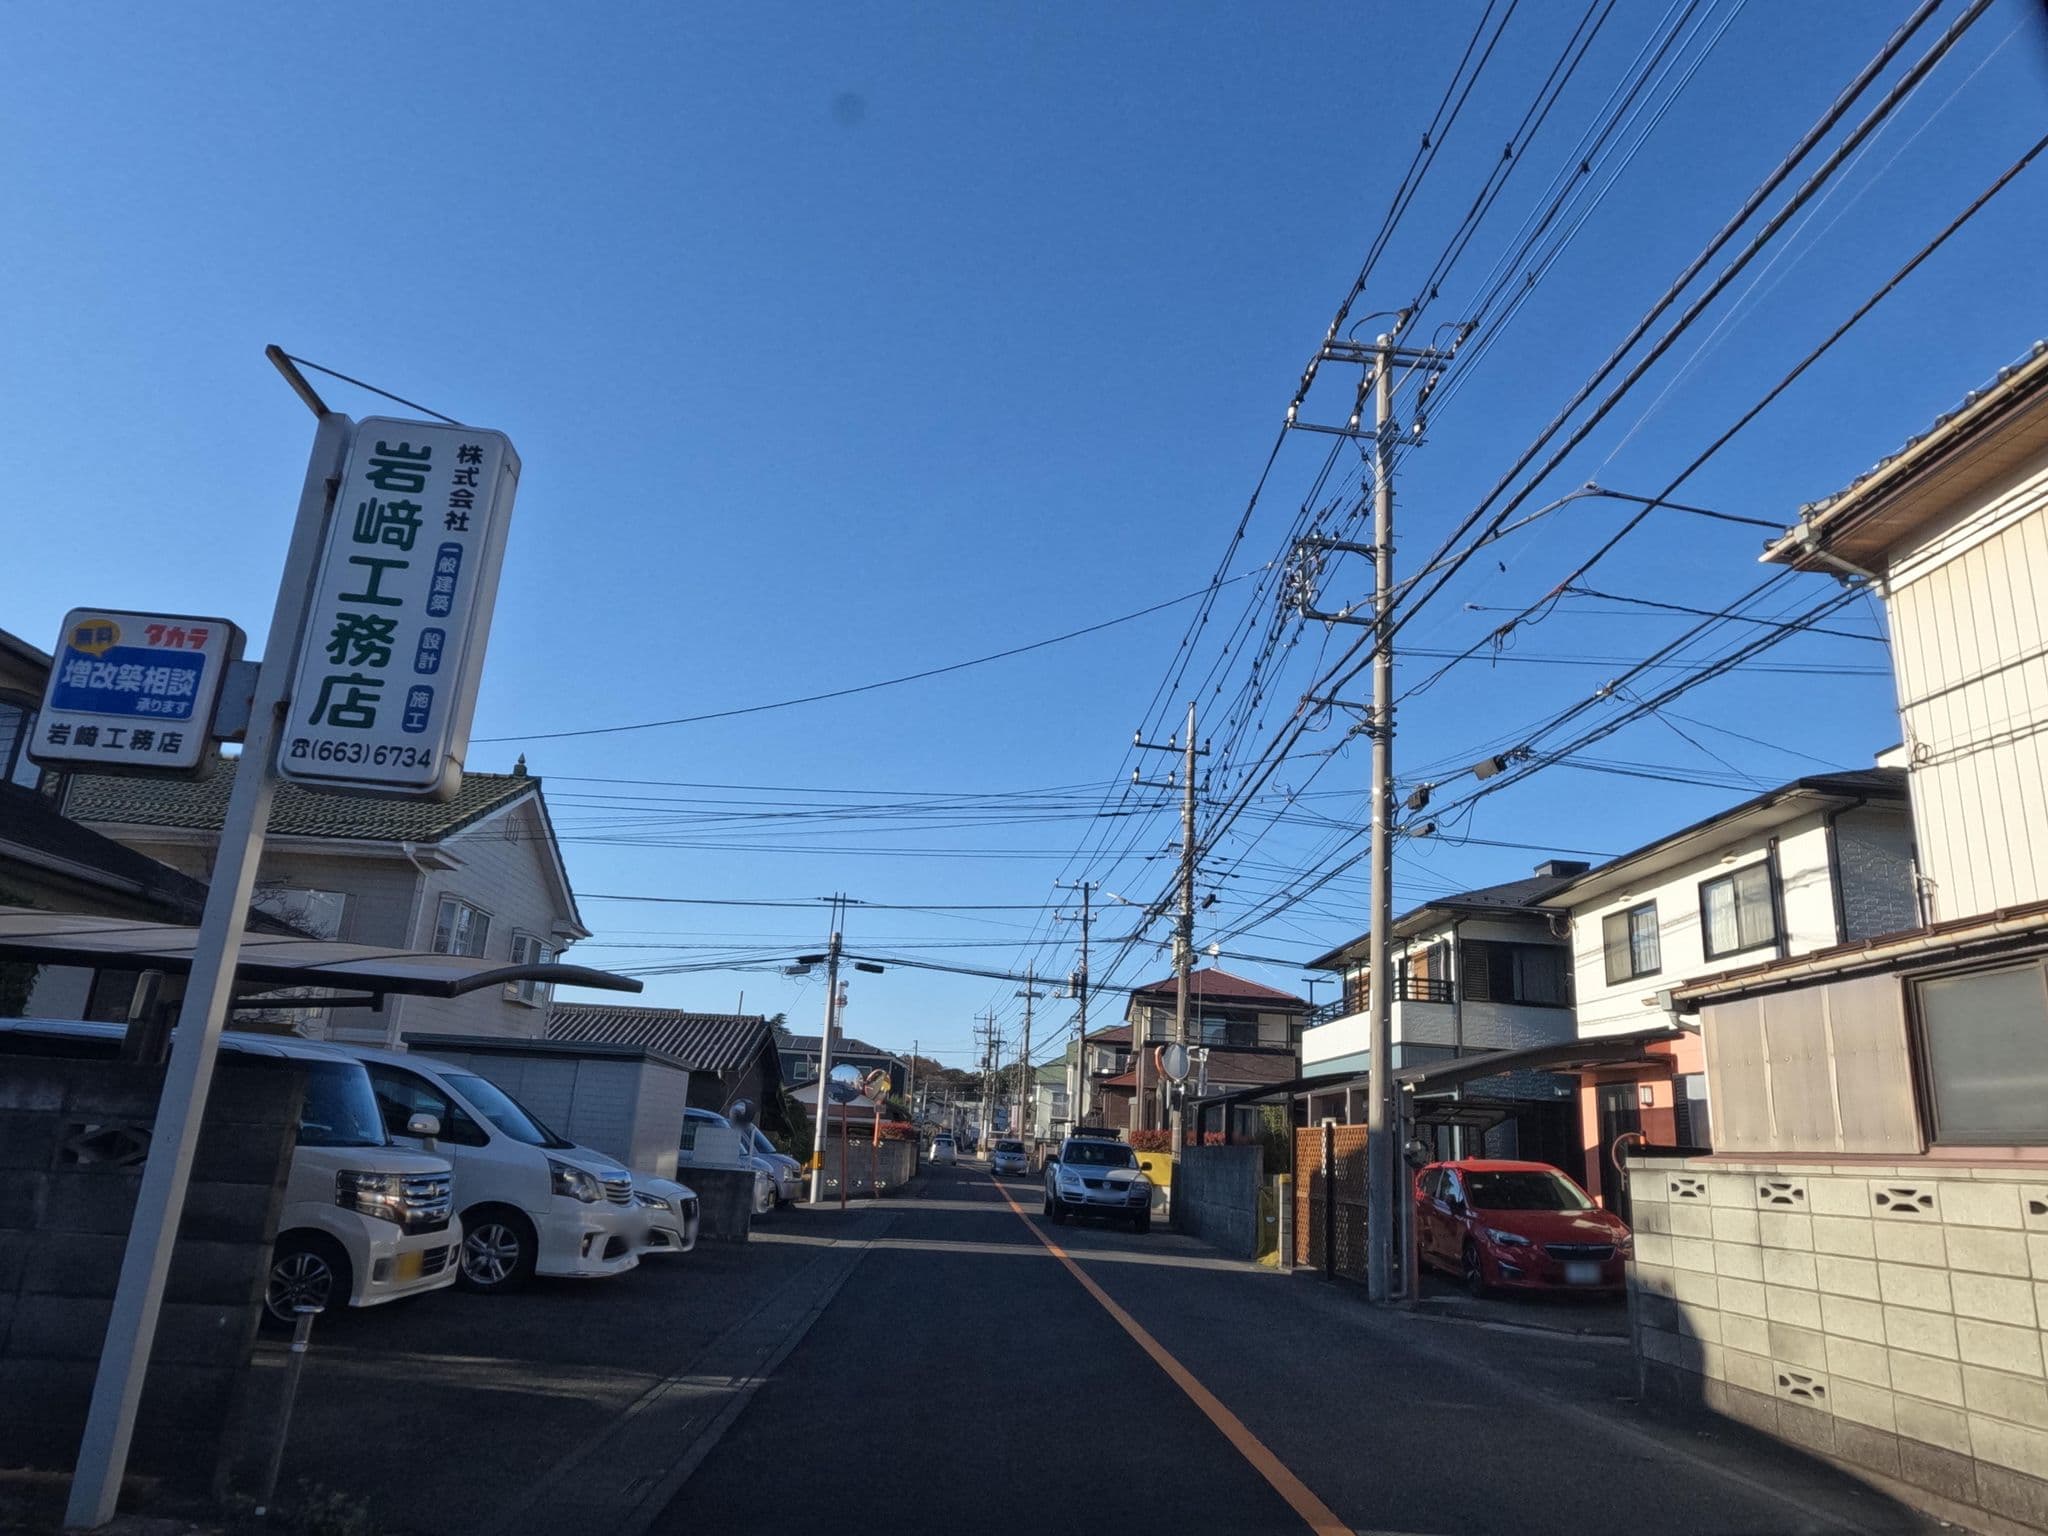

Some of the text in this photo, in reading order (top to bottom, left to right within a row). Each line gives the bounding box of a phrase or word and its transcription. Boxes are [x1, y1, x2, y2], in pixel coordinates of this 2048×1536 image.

[443, 443, 484, 533] 株式会社
[144, 624, 209, 649] タカラ
[418, 632, 442, 672] 設計
[61, 659, 197, 697] 増改築相談
[135, 697, 190, 715] 承ります
[406, 690, 430, 729] 施工
